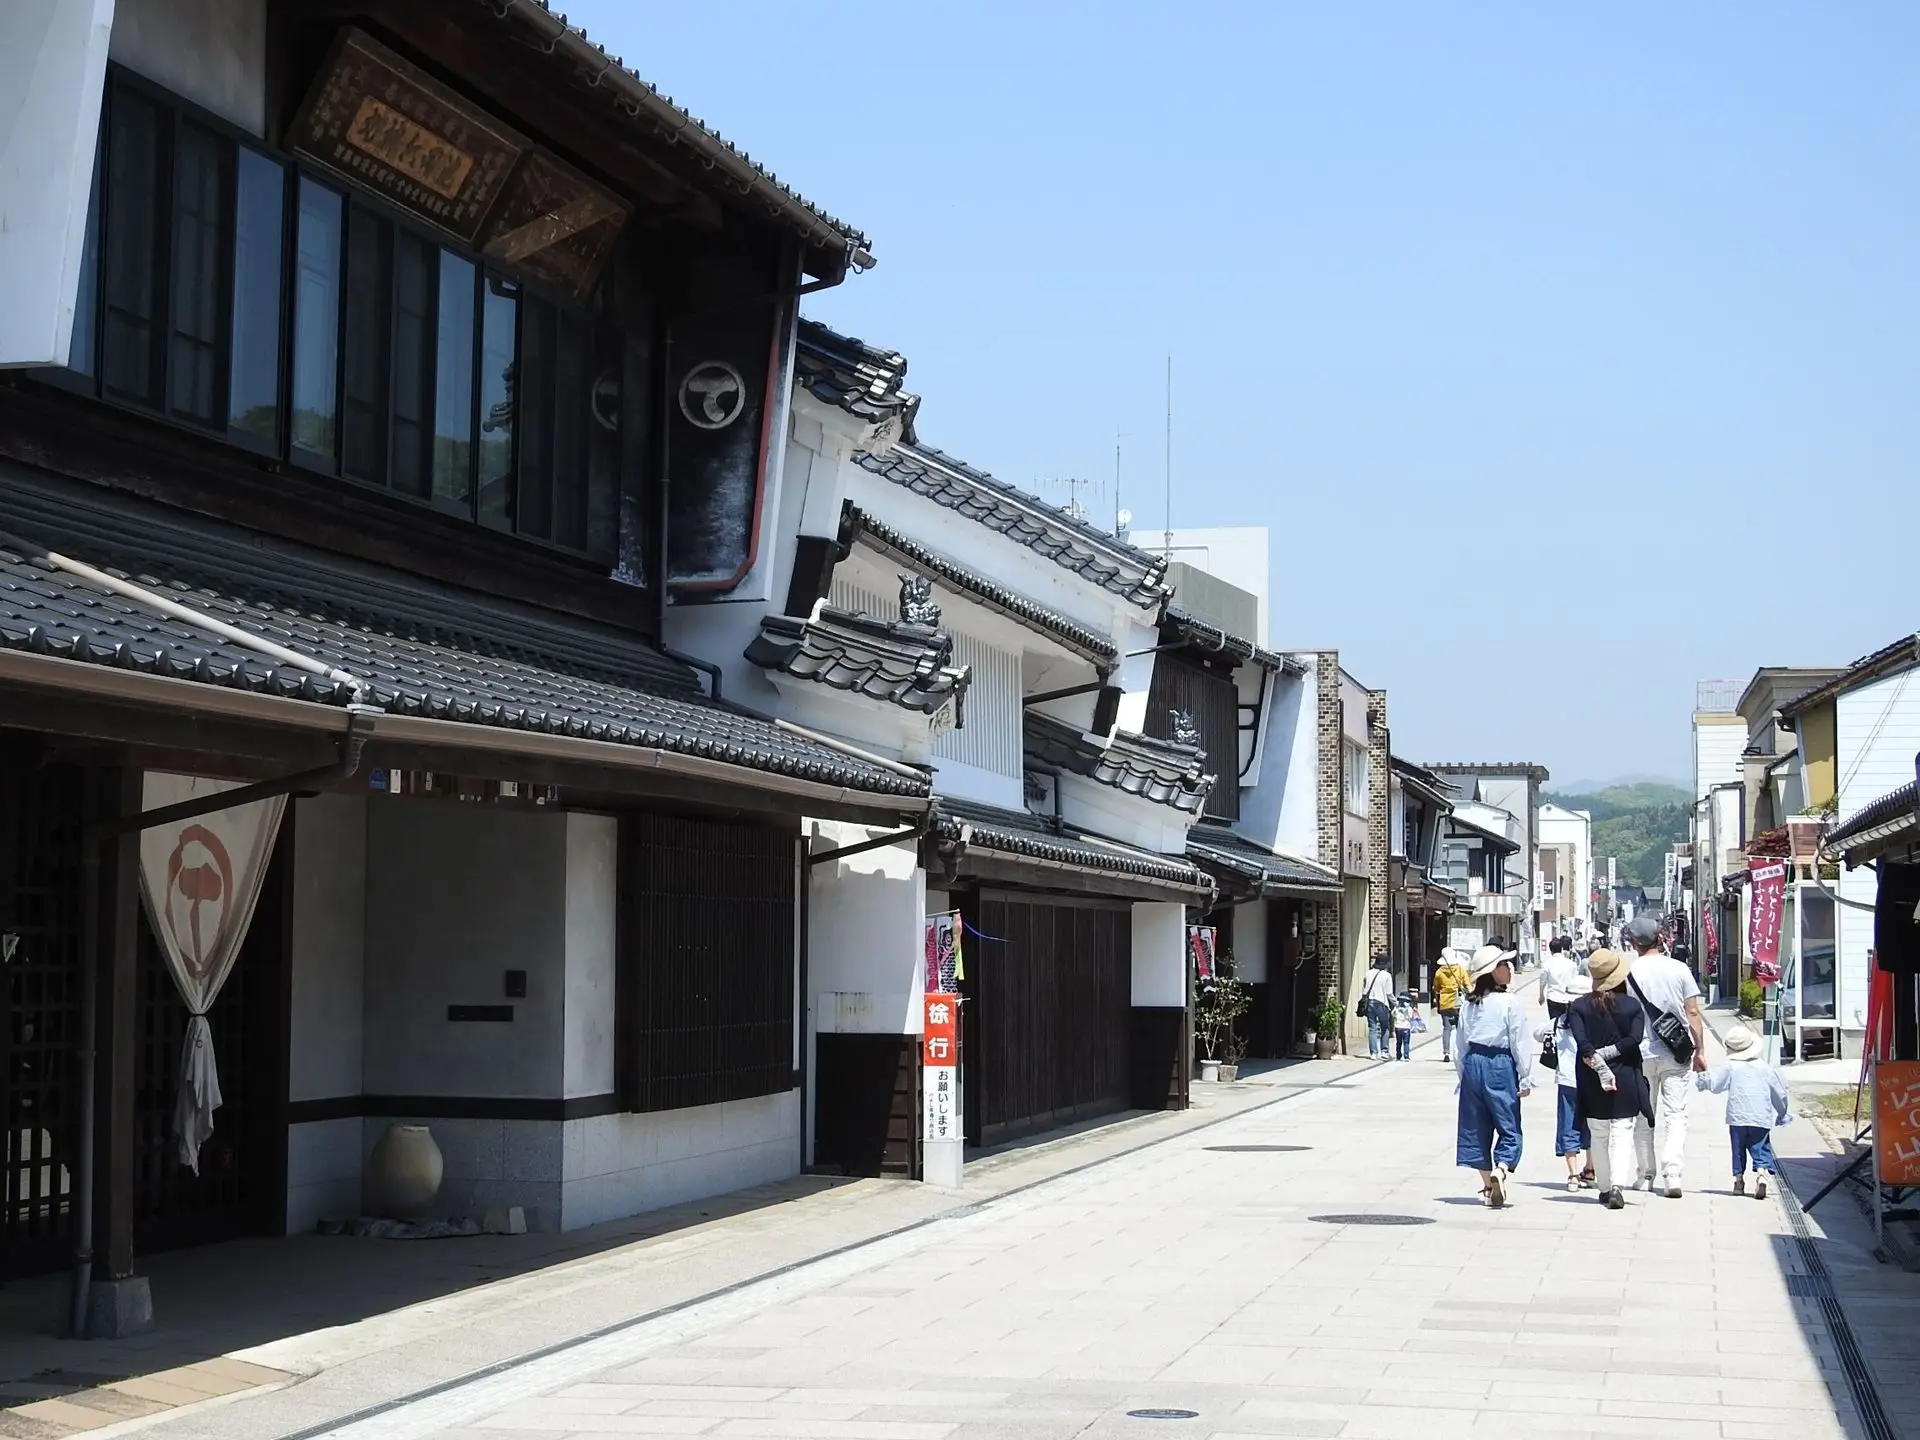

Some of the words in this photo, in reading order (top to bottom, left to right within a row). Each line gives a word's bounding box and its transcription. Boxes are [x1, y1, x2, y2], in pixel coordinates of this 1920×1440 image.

[929, 1002, 949, 1058] 徐行
[938, 1071, 948, 1136] お願いします
